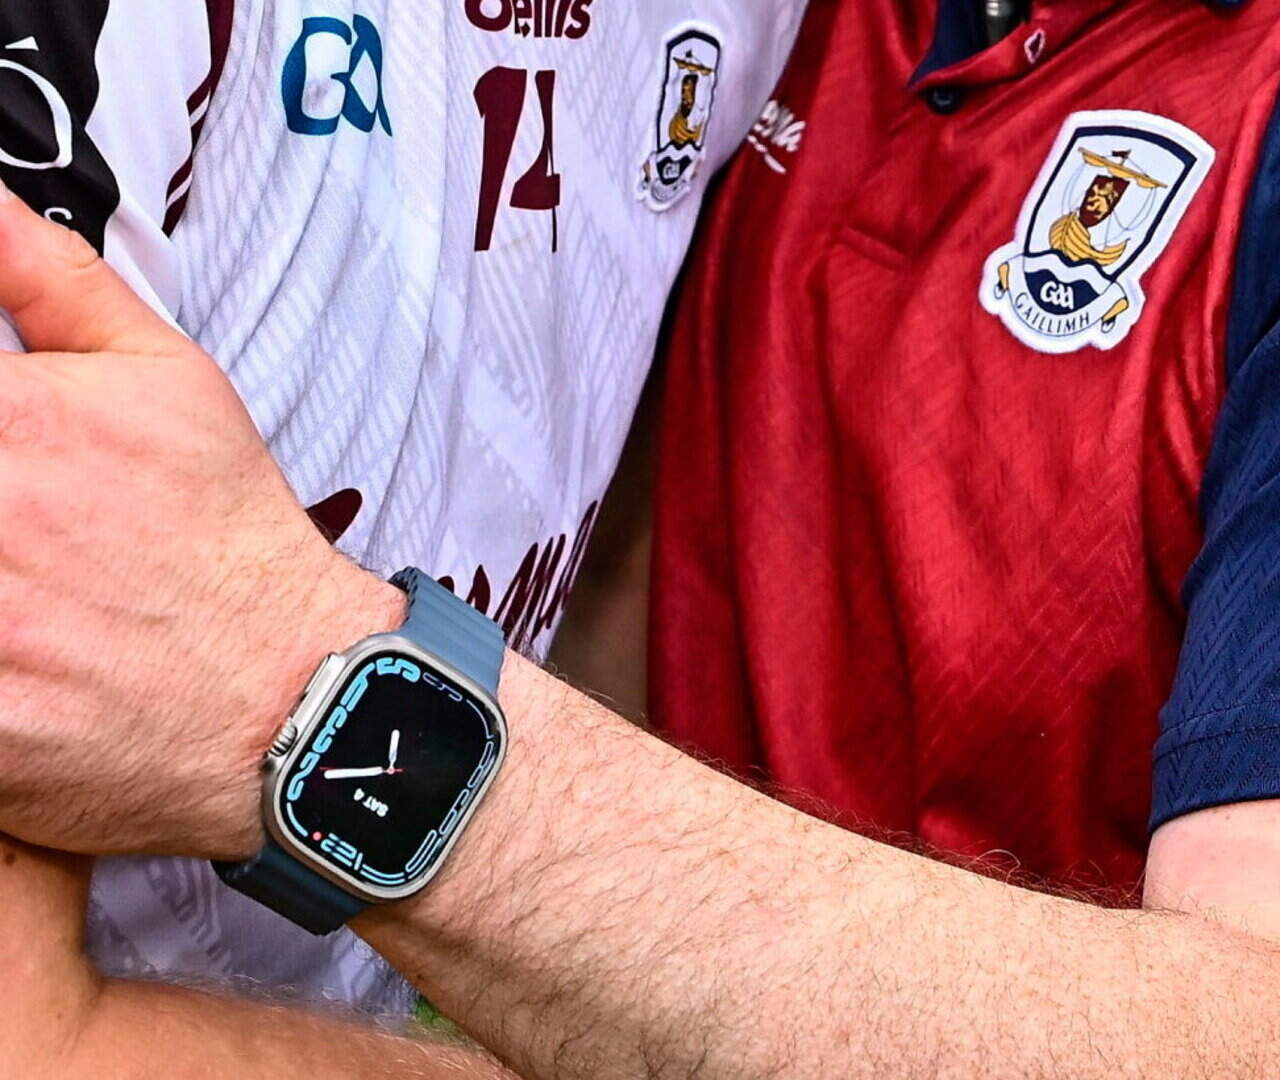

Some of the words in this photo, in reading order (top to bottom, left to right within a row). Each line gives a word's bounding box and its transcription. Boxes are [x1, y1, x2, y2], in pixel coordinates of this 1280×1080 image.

[473, 65, 561, 253] 14
[1014, 291, 1090, 333] GAILLIMH
[362, 795, 389, 818] SAT
